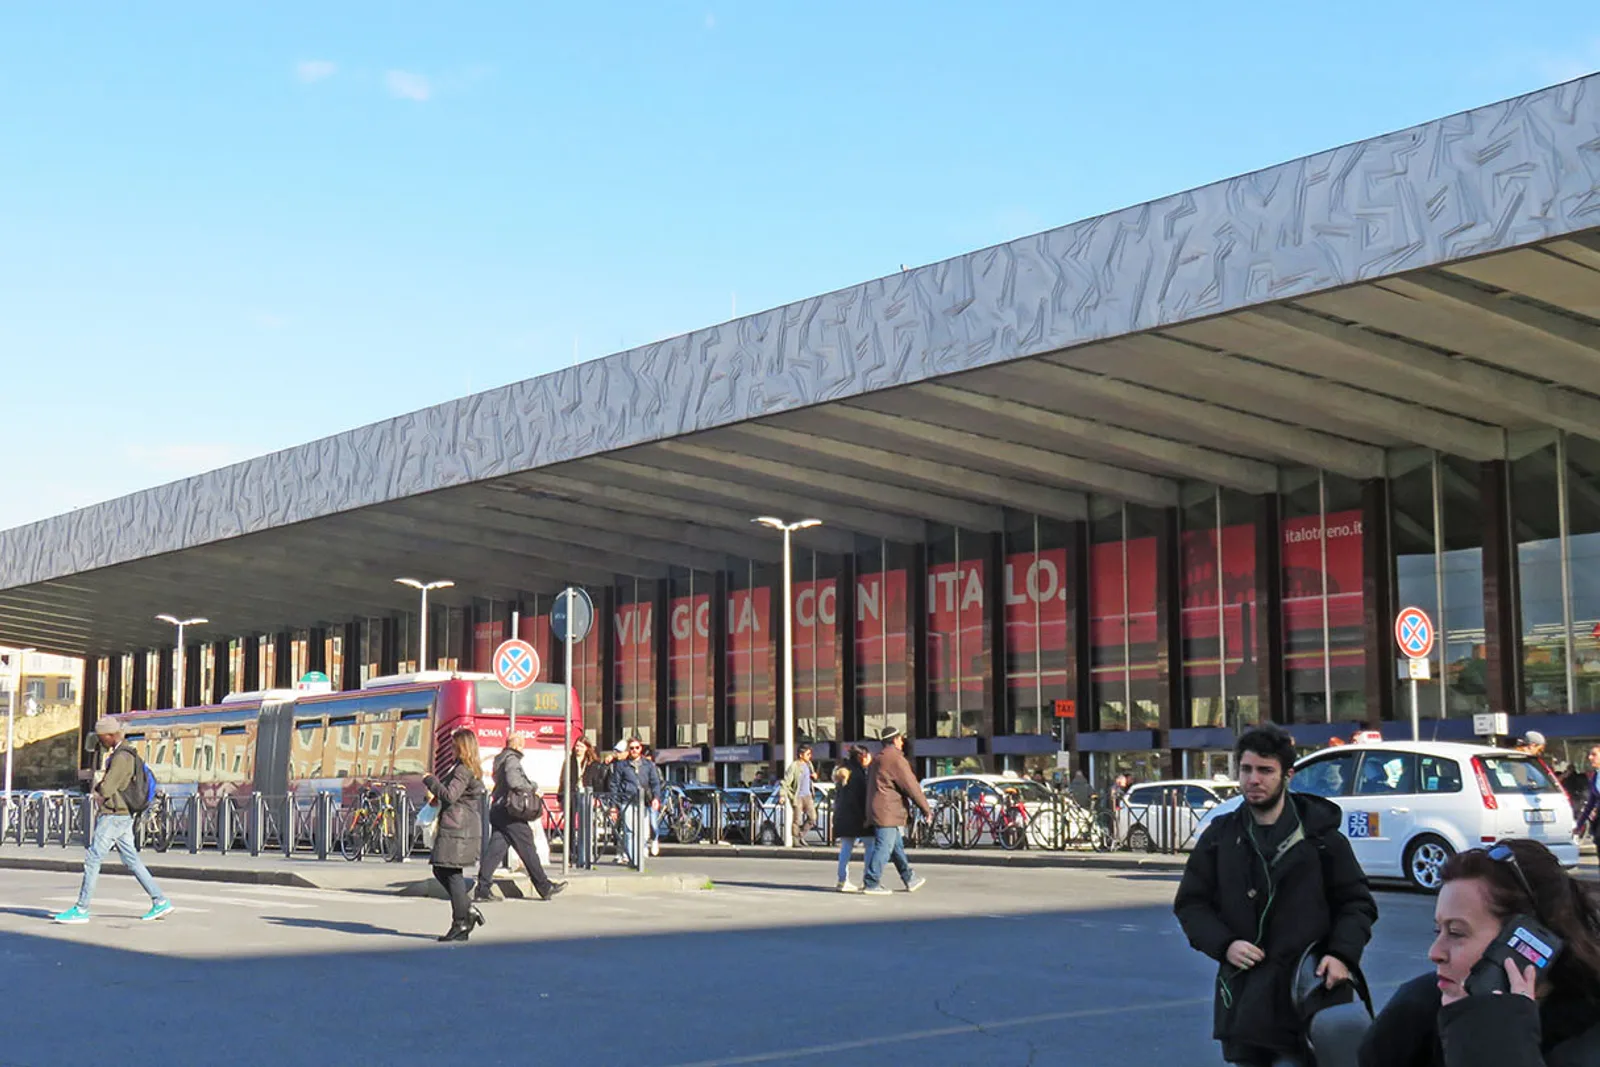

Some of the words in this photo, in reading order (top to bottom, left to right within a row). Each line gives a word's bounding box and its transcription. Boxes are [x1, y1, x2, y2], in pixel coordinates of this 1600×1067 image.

[535, 692, 559, 711] 105
[1350, 813, 1368, 825] 35
[1350, 825, 1368, 836] 70
